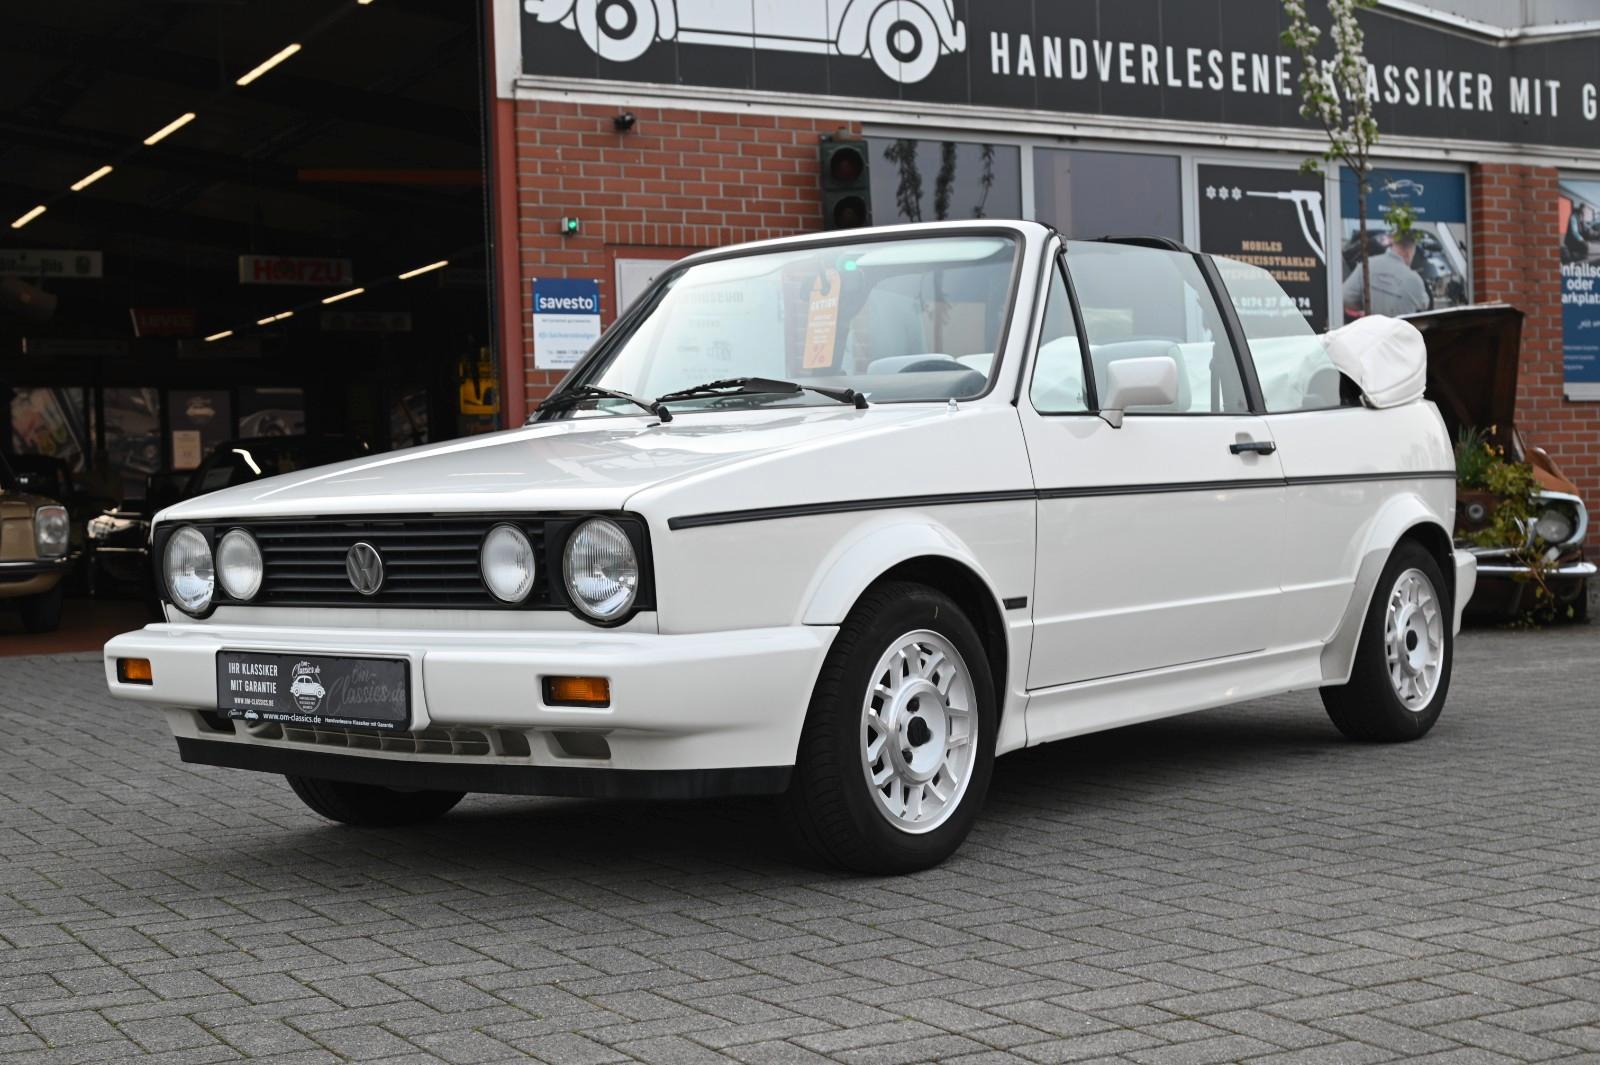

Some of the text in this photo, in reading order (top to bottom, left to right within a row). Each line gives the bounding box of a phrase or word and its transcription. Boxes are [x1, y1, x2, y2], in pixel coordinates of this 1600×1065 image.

[990, 31, 1293, 96] HANDVERLESENE
[1321, 59, 1493, 112] KASSIKER
[1510, 76, 1561, 117] MIT
[1566, 277, 1595, 291] oder
[228, 662, 278, 677] IHR KLASSIKER
[230, 679, 277, 694] MIT GARANTIE
[262, 712, 322, 725] www.om-classics.de
